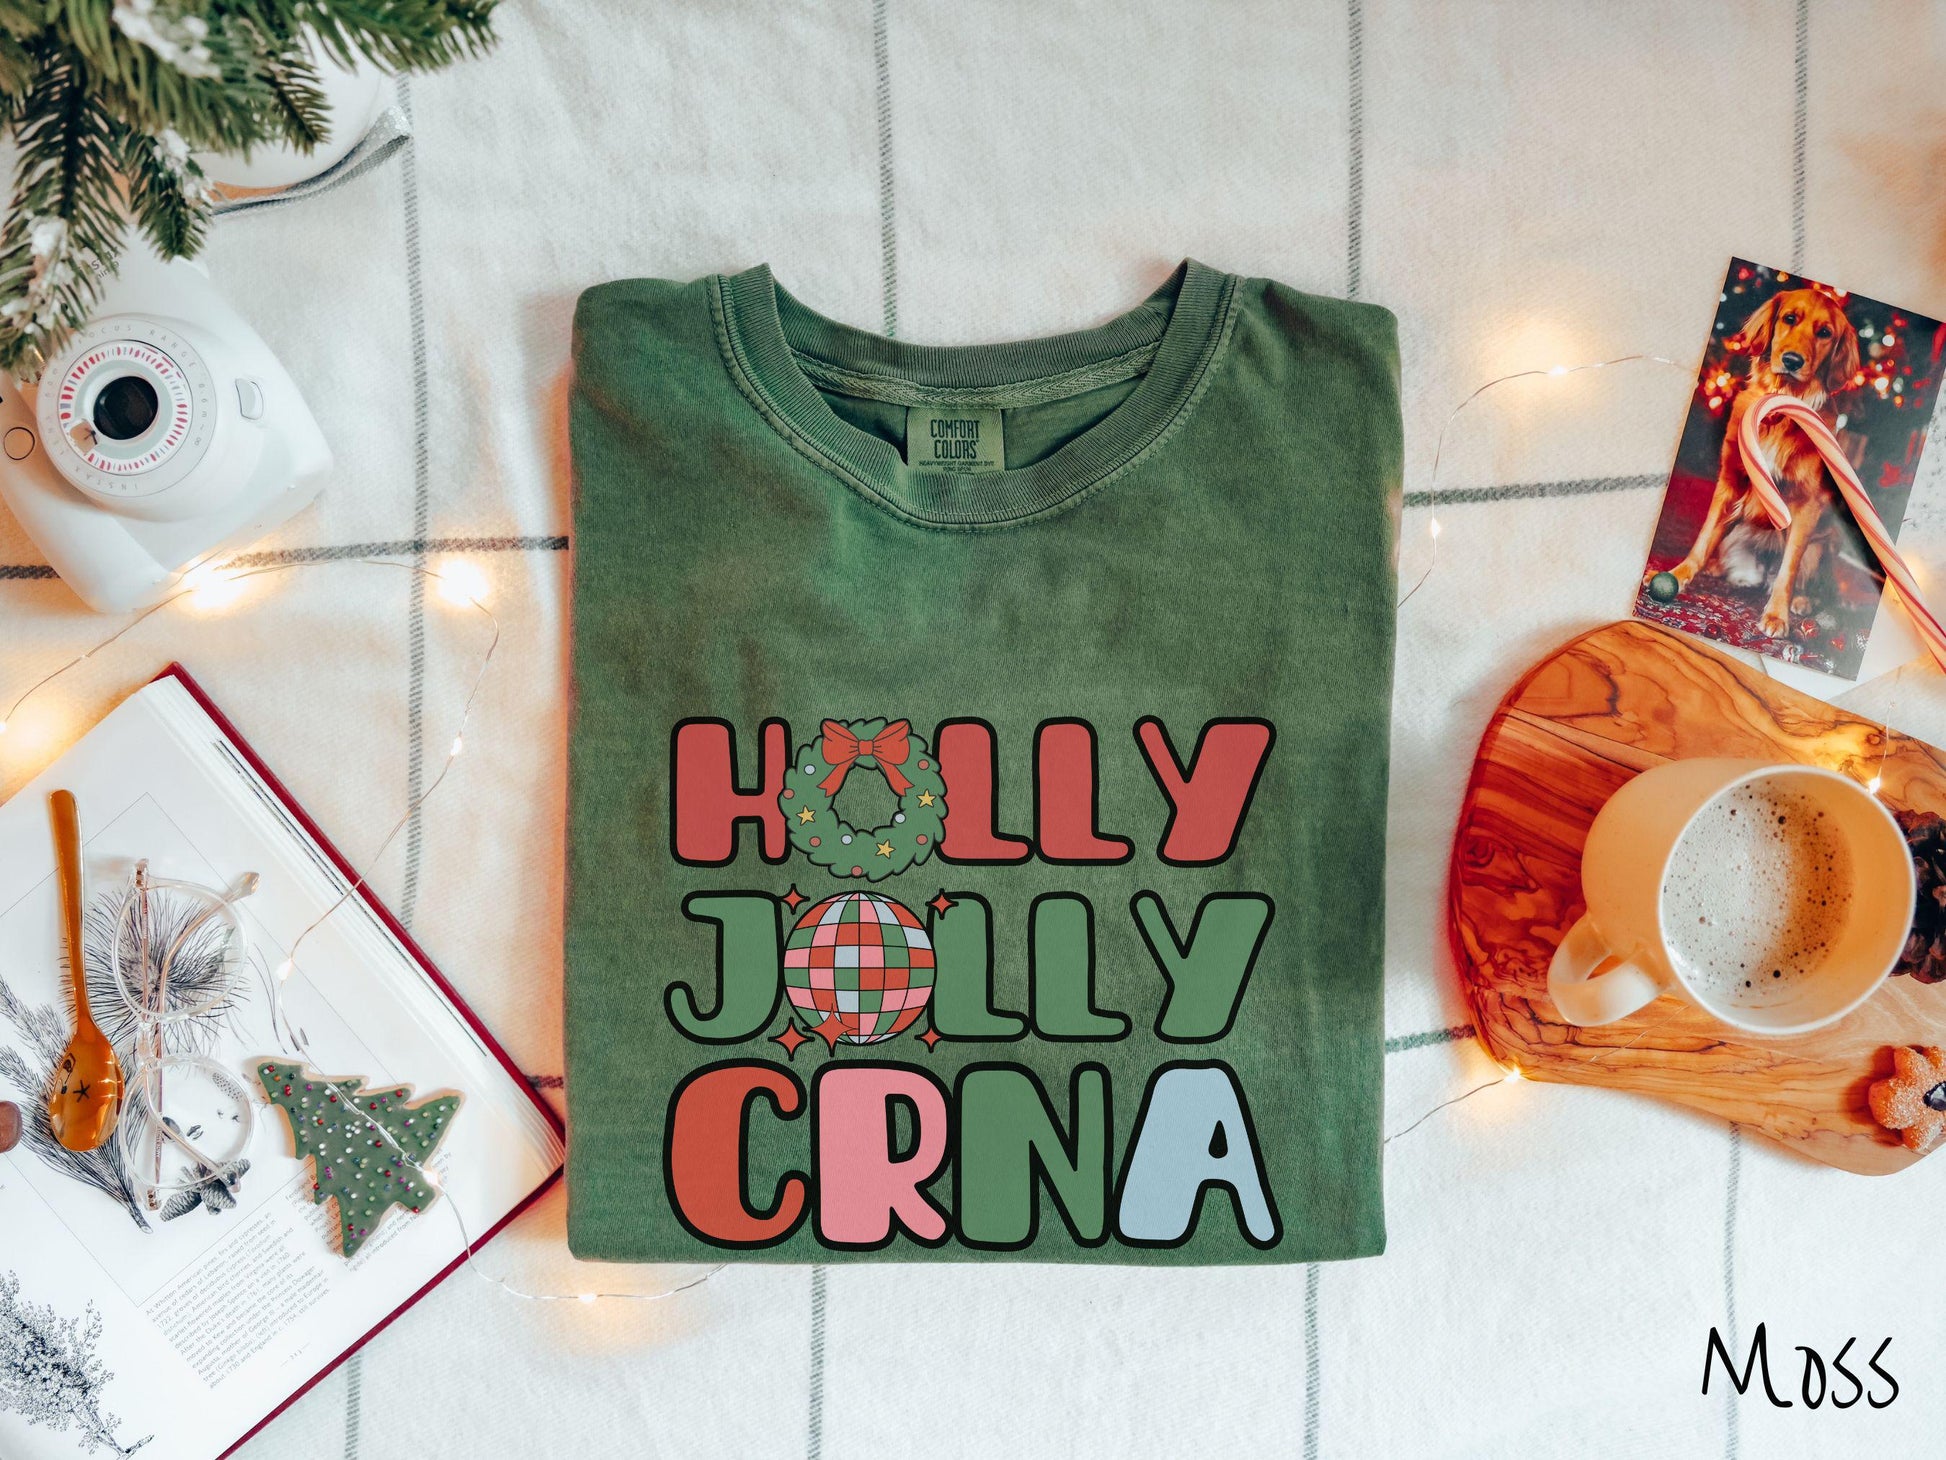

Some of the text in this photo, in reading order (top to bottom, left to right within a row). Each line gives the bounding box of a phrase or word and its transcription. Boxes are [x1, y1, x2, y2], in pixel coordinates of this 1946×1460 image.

[150, 330, 196, 368] RANGE
[930, 419, 980, 439] COMFORT
[934, 439, 977, 460] COLORS
[670, 714, 1278, 882] HOLLY
[663, 889, 1276, 1046] JOLLY
[662, 1056, 1285, 1253] CRNA
